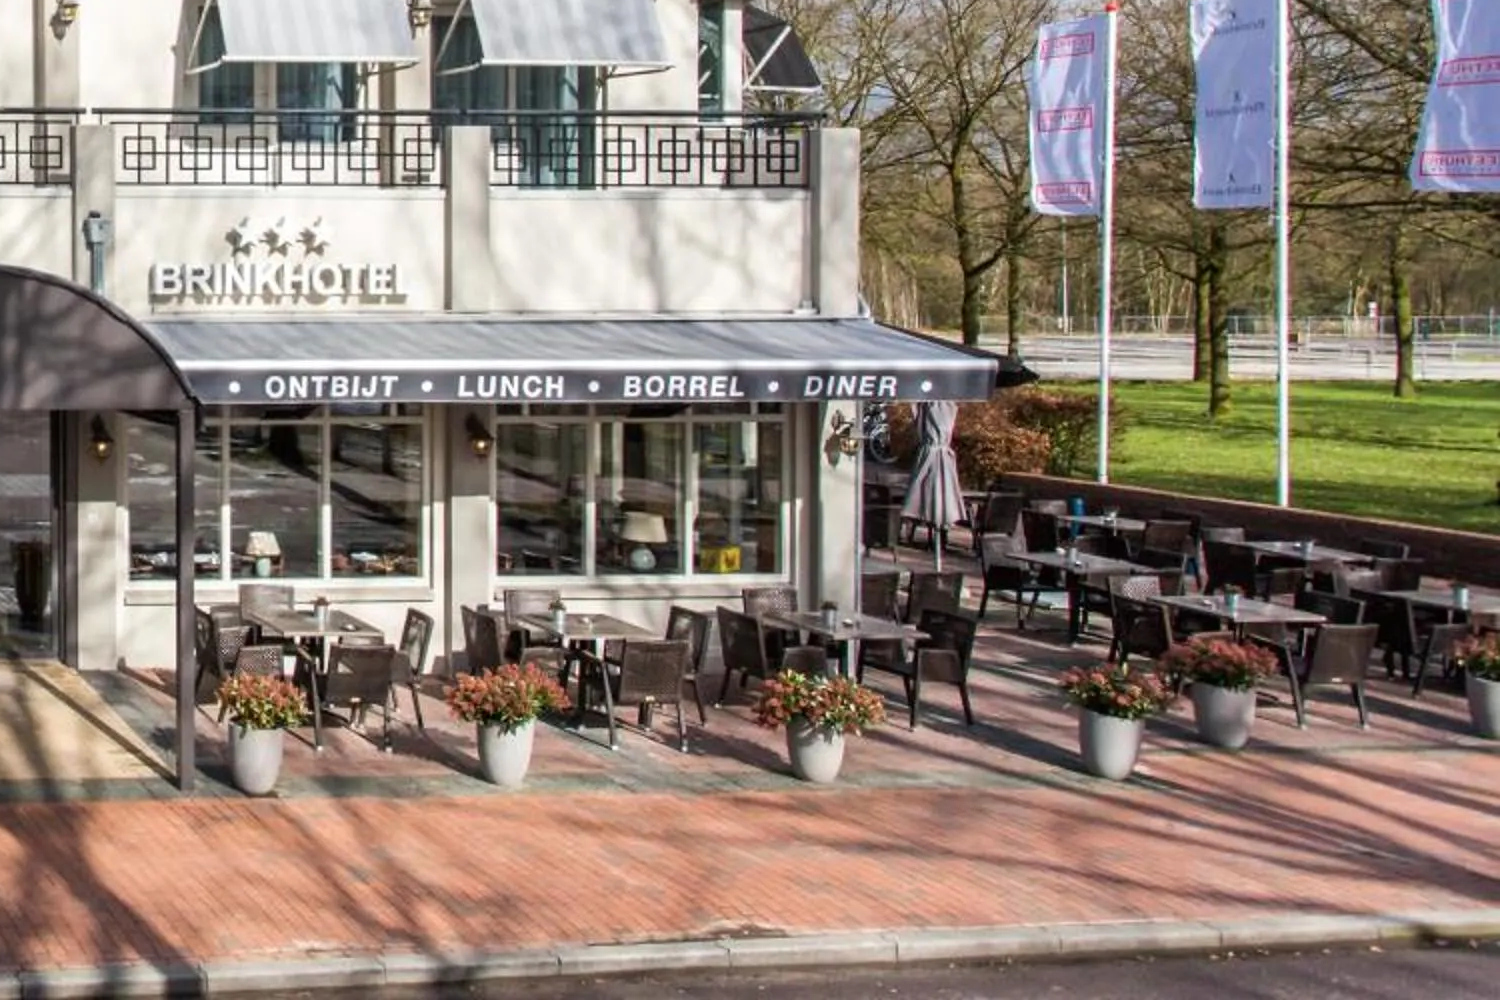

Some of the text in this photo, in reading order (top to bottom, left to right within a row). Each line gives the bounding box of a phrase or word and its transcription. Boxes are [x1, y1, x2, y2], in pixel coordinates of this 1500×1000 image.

[150, 262, 408, 297] BRINKHOTEL
[264, 375, 899, 399] ONTBIJT LUNCH BORREL DINER
